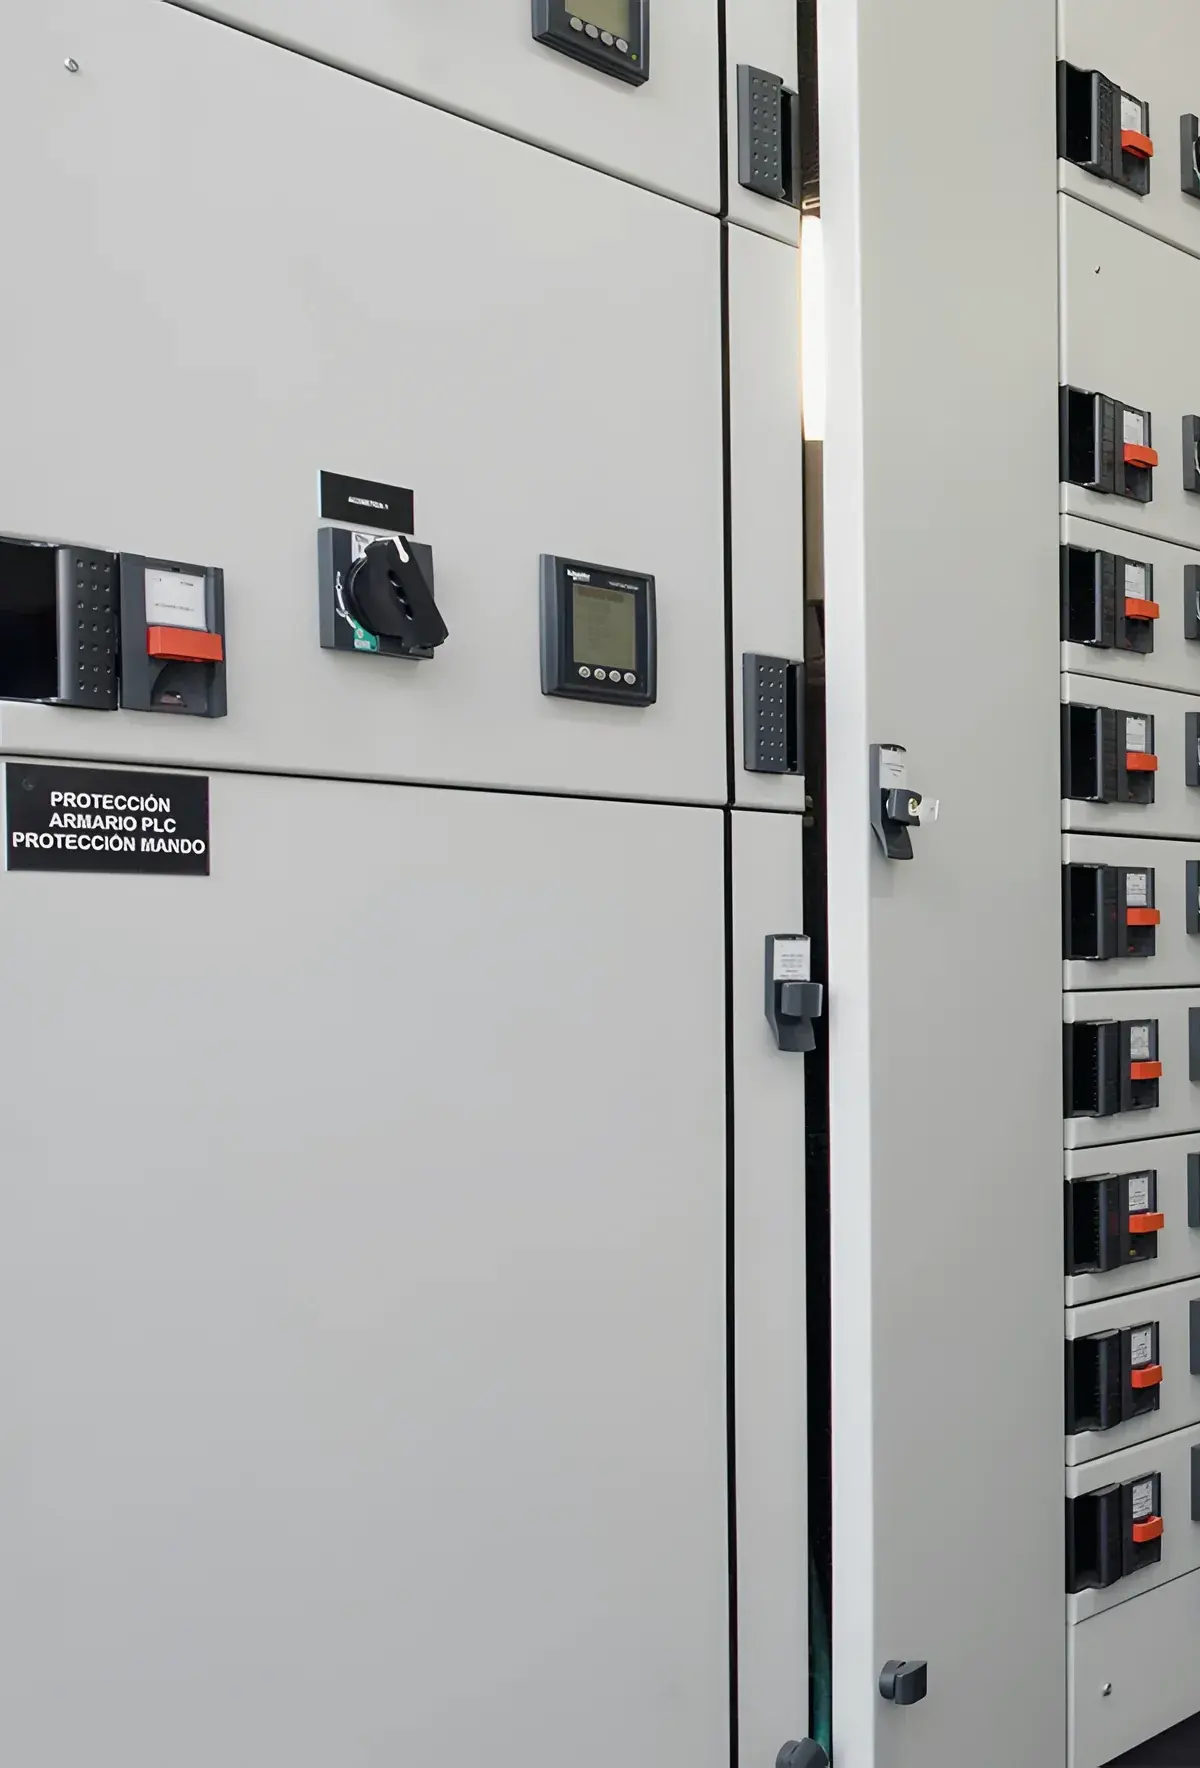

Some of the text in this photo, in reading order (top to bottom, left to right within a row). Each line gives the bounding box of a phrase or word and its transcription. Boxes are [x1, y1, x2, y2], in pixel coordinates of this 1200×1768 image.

[50, 791, 171, 812] PROTECCIÓN
[48, 812, 177, 833] ARMARIO PLC
[12, 831, 206, 854] PROTECCIÓN MANDO
